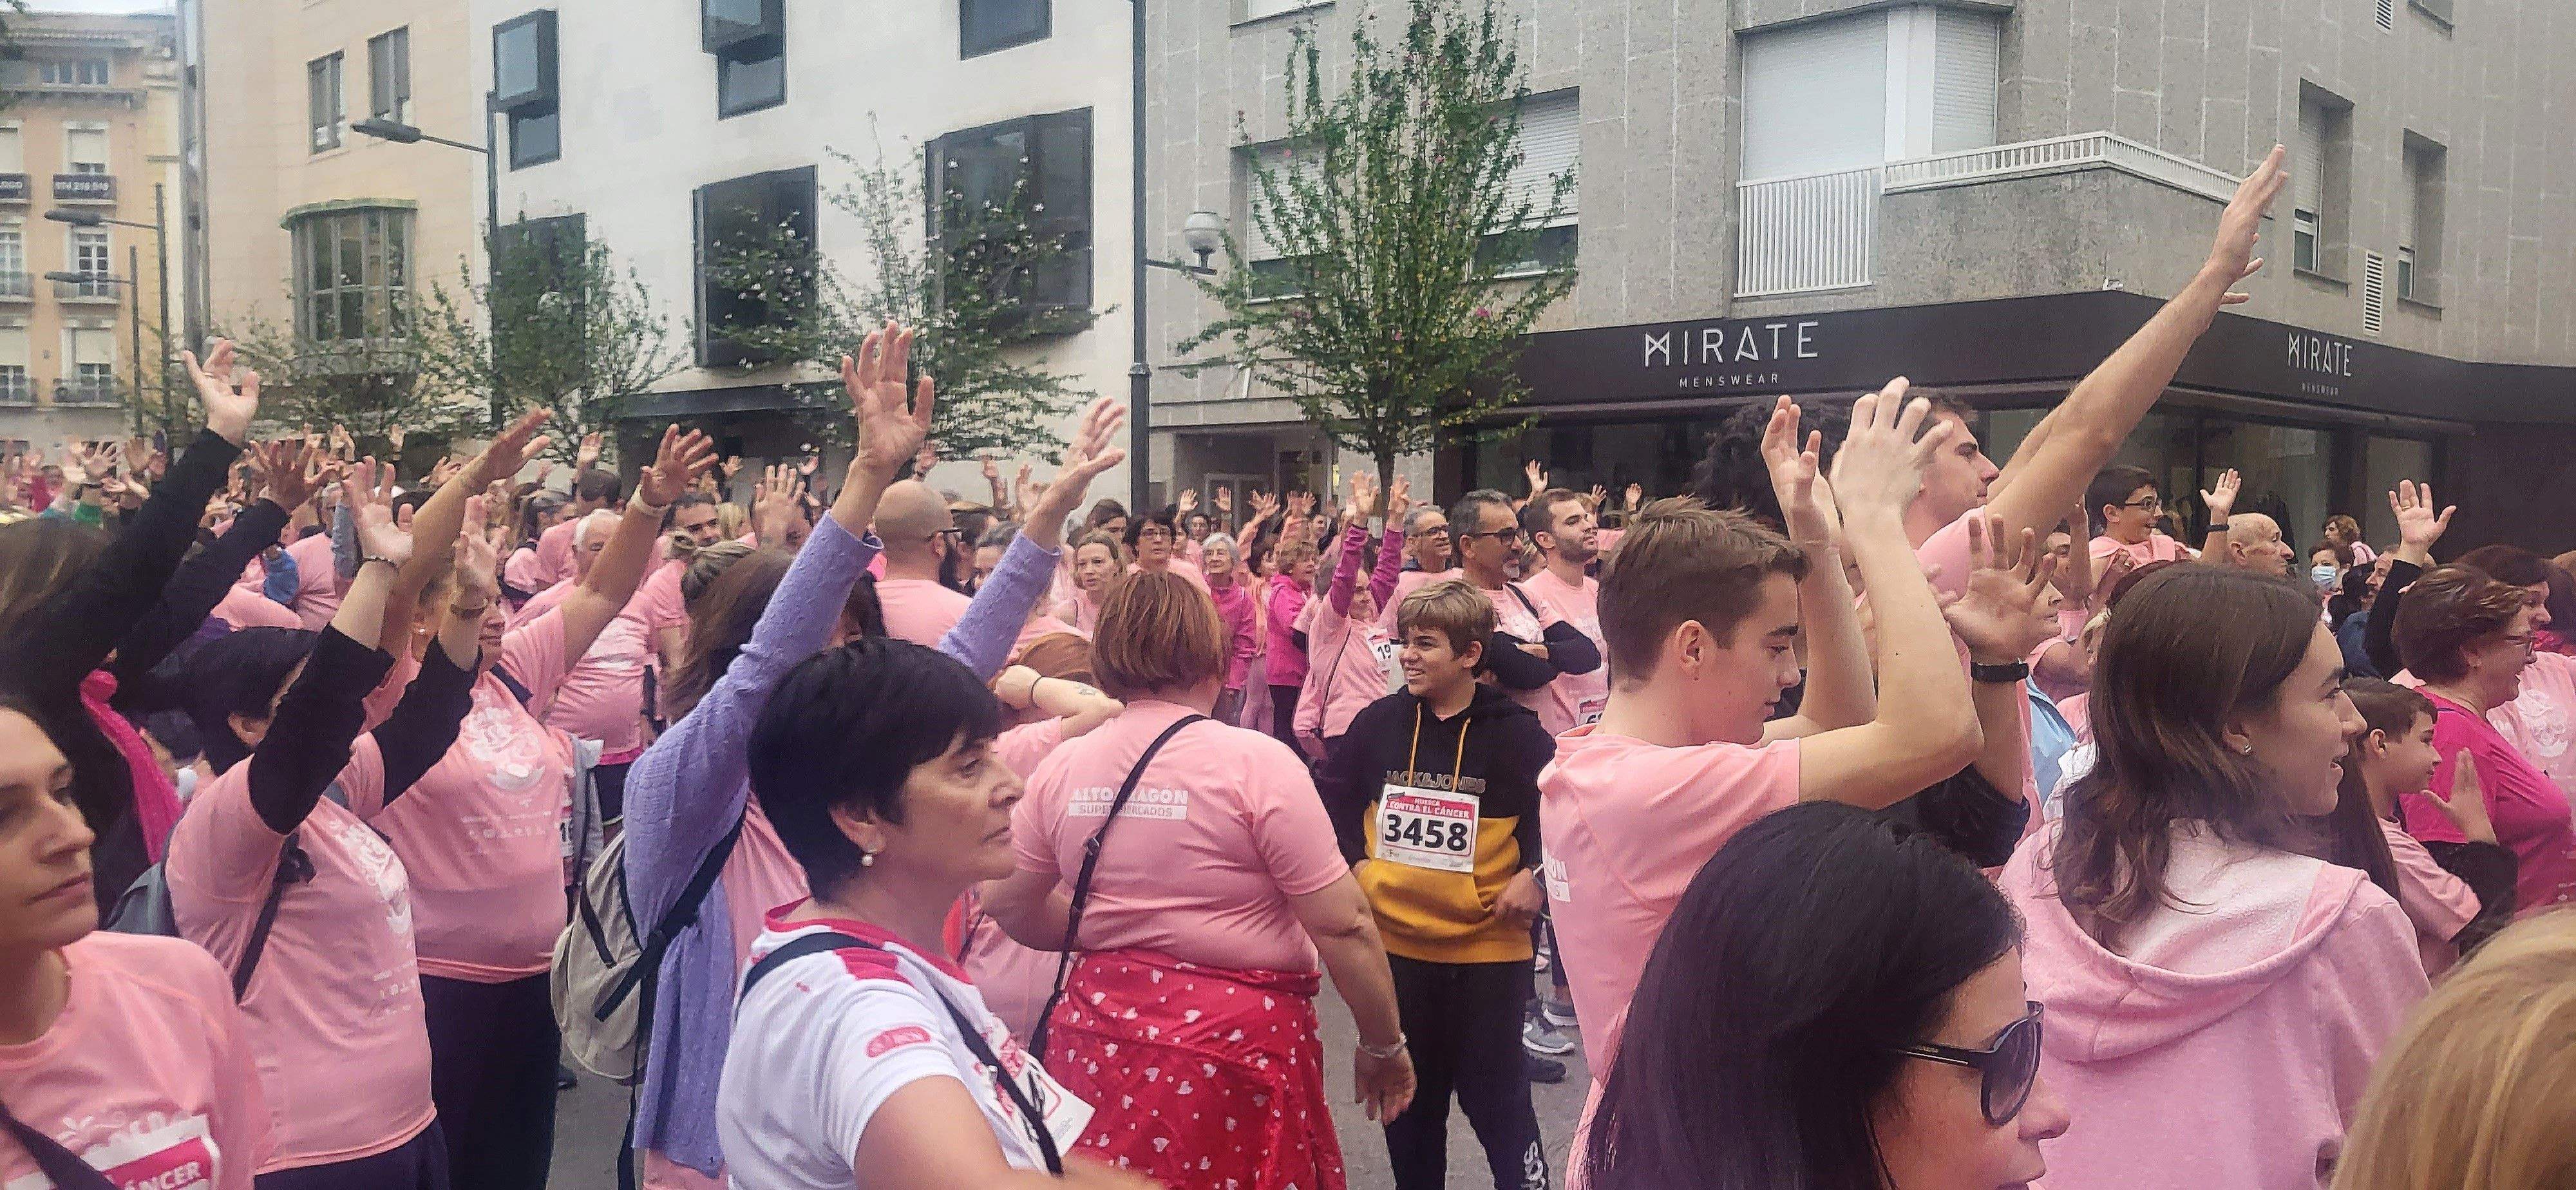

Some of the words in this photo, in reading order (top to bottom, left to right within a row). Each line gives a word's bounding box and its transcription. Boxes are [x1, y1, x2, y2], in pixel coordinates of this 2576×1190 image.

[1645, 321, 1819, 367] MIRATE
[2287, 332, 2353, 377] MIRATE
[1679, 373, 1779, 388] MENSWEAR
[1079, 804, 1173, 817] SUPEERCADOS
[1388, 800, 1421, 813] CONTRA
[1422, 805, 1432, 814] EL
[1434, 806, 1470, 819] CÁNCER
[1414, 797, 1441, 807] HUESCA
[1385, 813, 1468, 851] 3458
